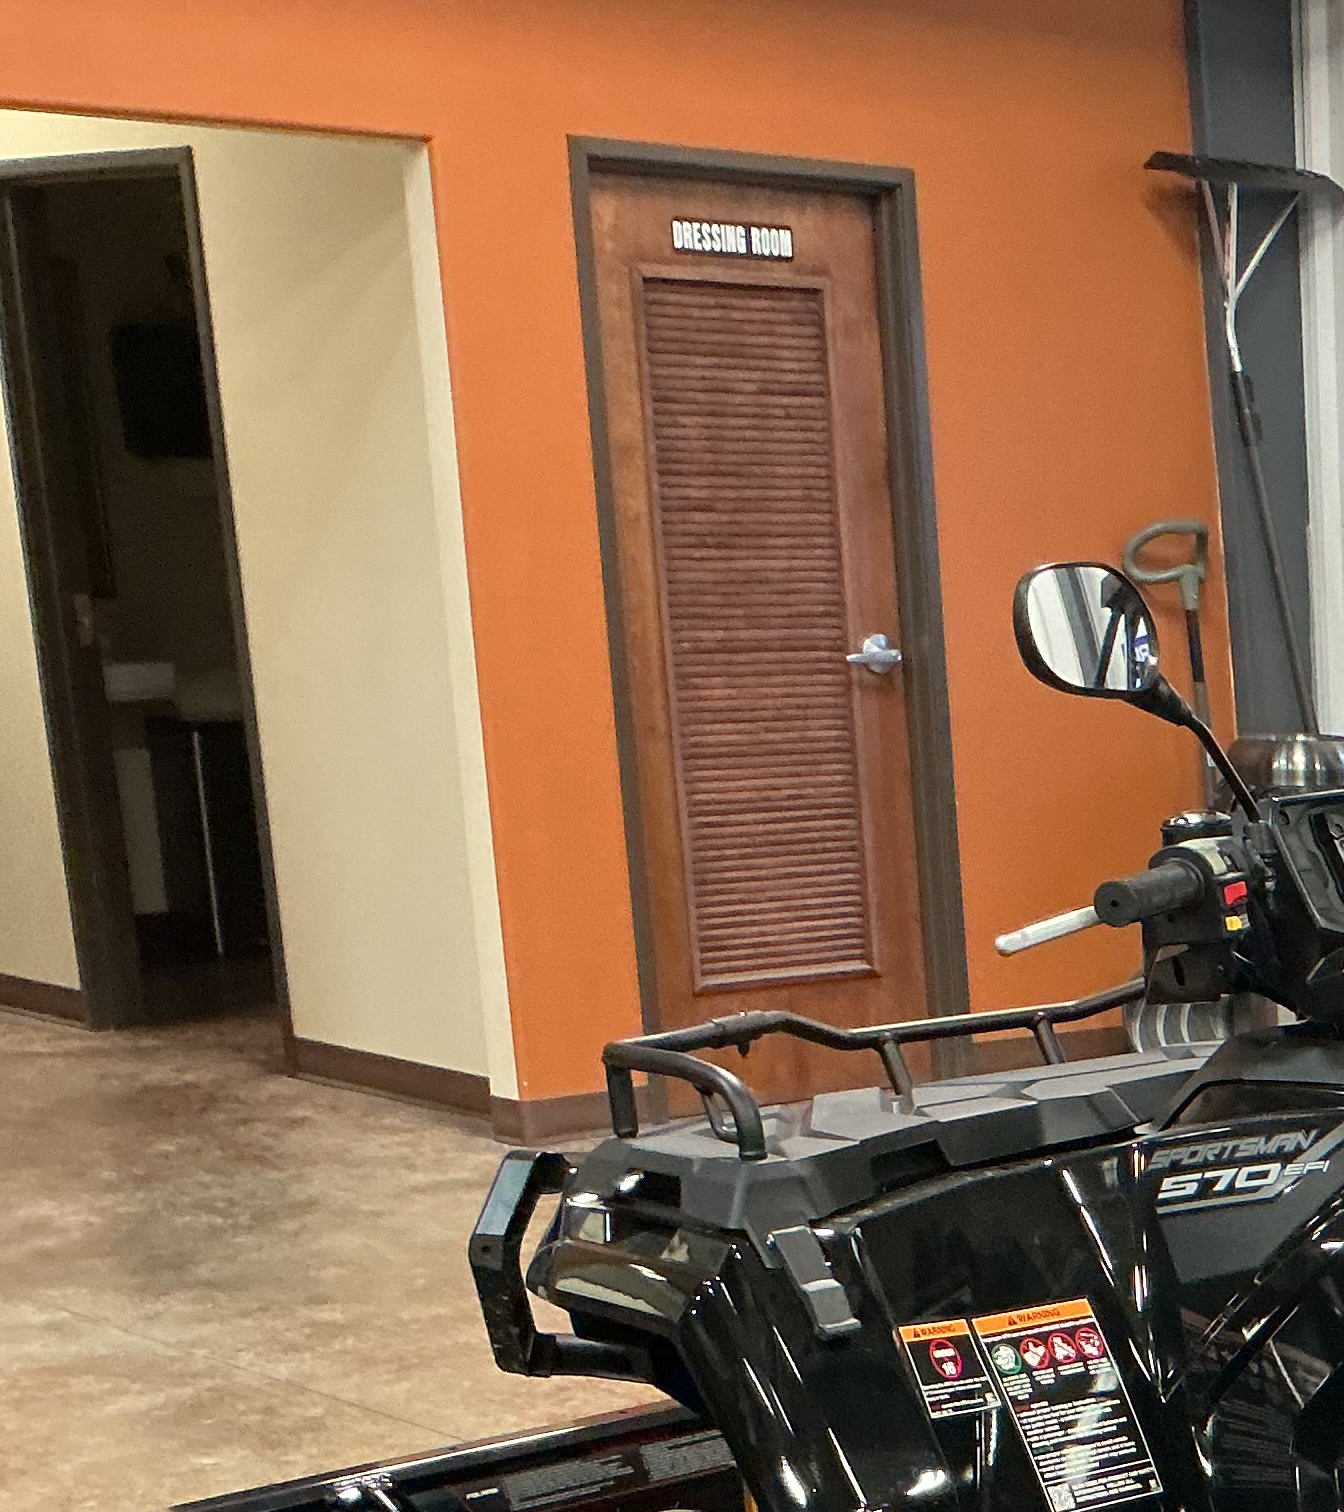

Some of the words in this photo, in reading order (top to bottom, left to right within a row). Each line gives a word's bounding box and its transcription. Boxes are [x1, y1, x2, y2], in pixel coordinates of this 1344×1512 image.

[672, 220, 748, 254] DRESSING
[750, 227, 793, 258] ROOM
[1150, 1128, 1321, 1170] SPORTSMAN
[1157, 1162, 1283, 1200] 570
[1284, 1160, 1331, 1177] EFI
